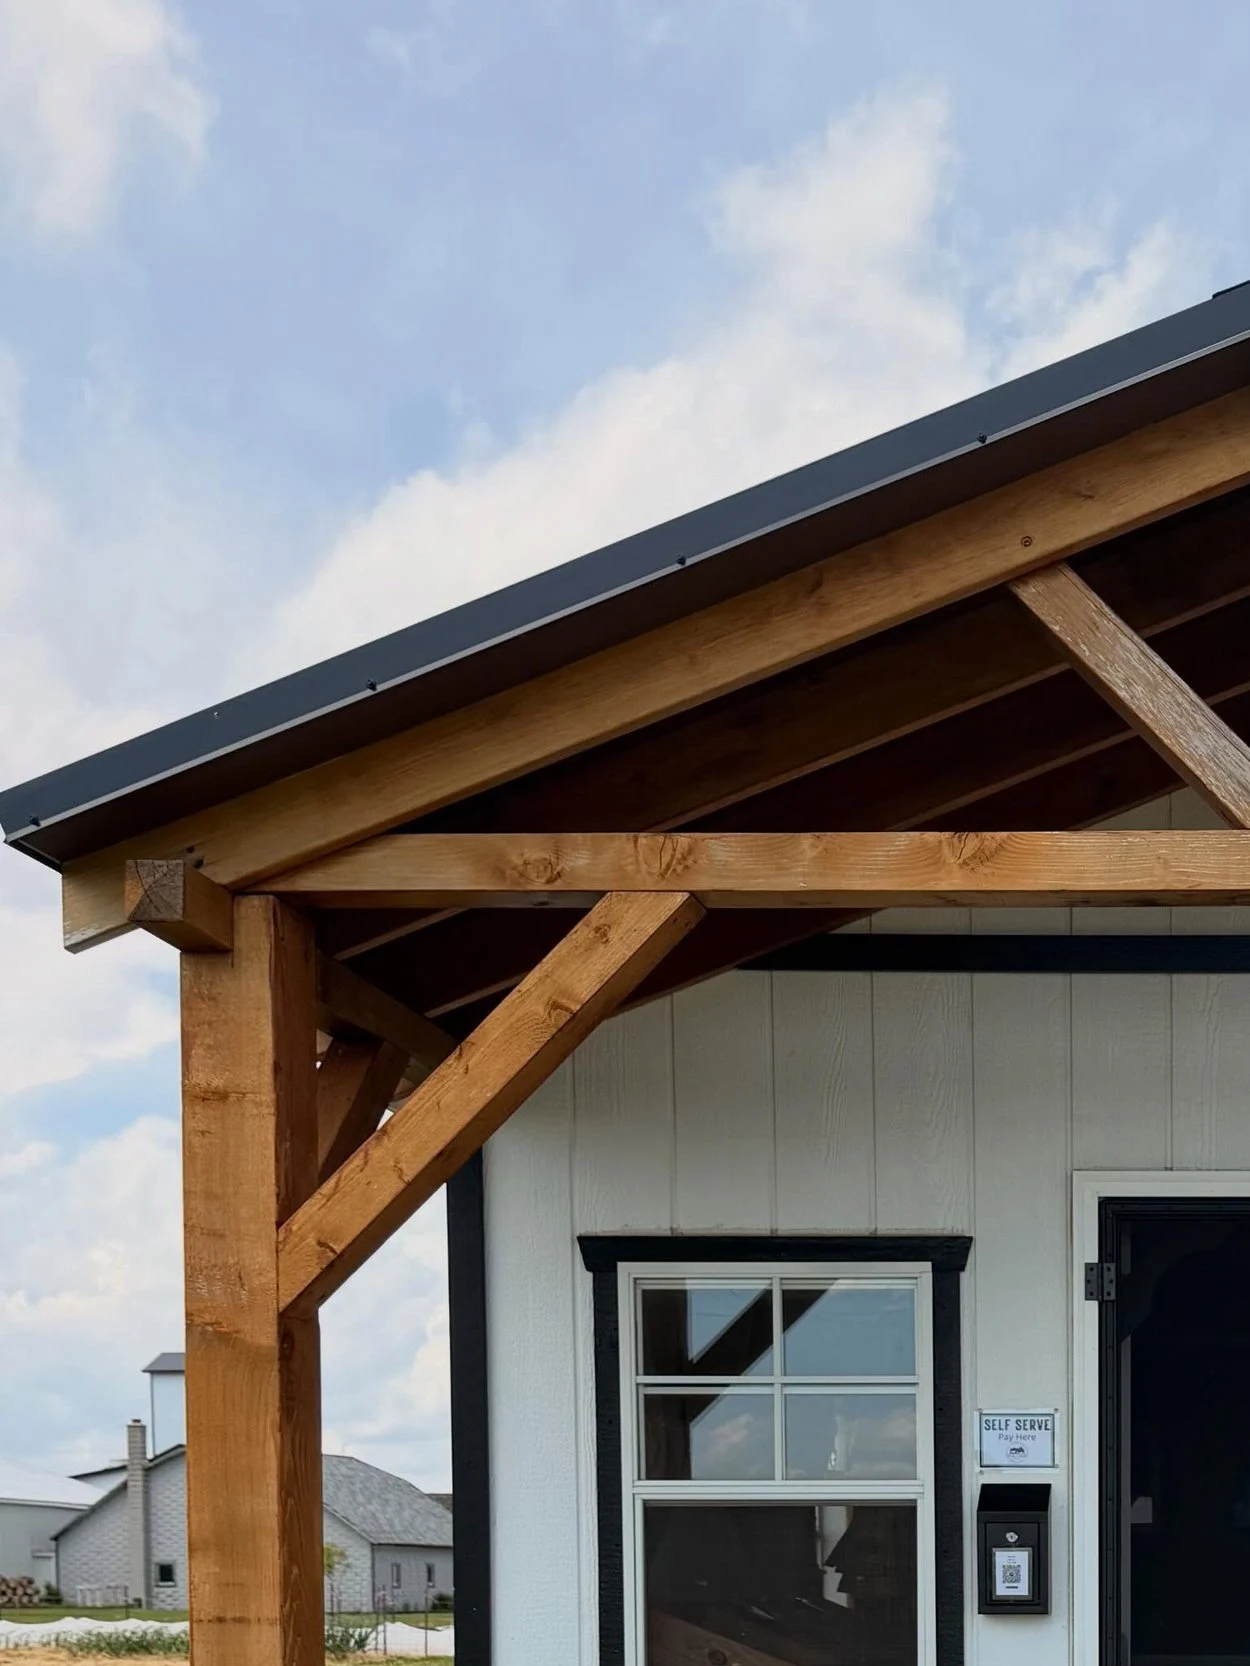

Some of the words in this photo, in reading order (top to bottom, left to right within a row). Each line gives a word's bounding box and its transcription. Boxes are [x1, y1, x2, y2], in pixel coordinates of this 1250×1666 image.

[984, 1418, 1011, 1431] SELF
[1015, 1418, 1051, 1431] SERVE
[998, 1433, 1014, 1442] Pay
[1016, 1433, 1037, 1441] Here
